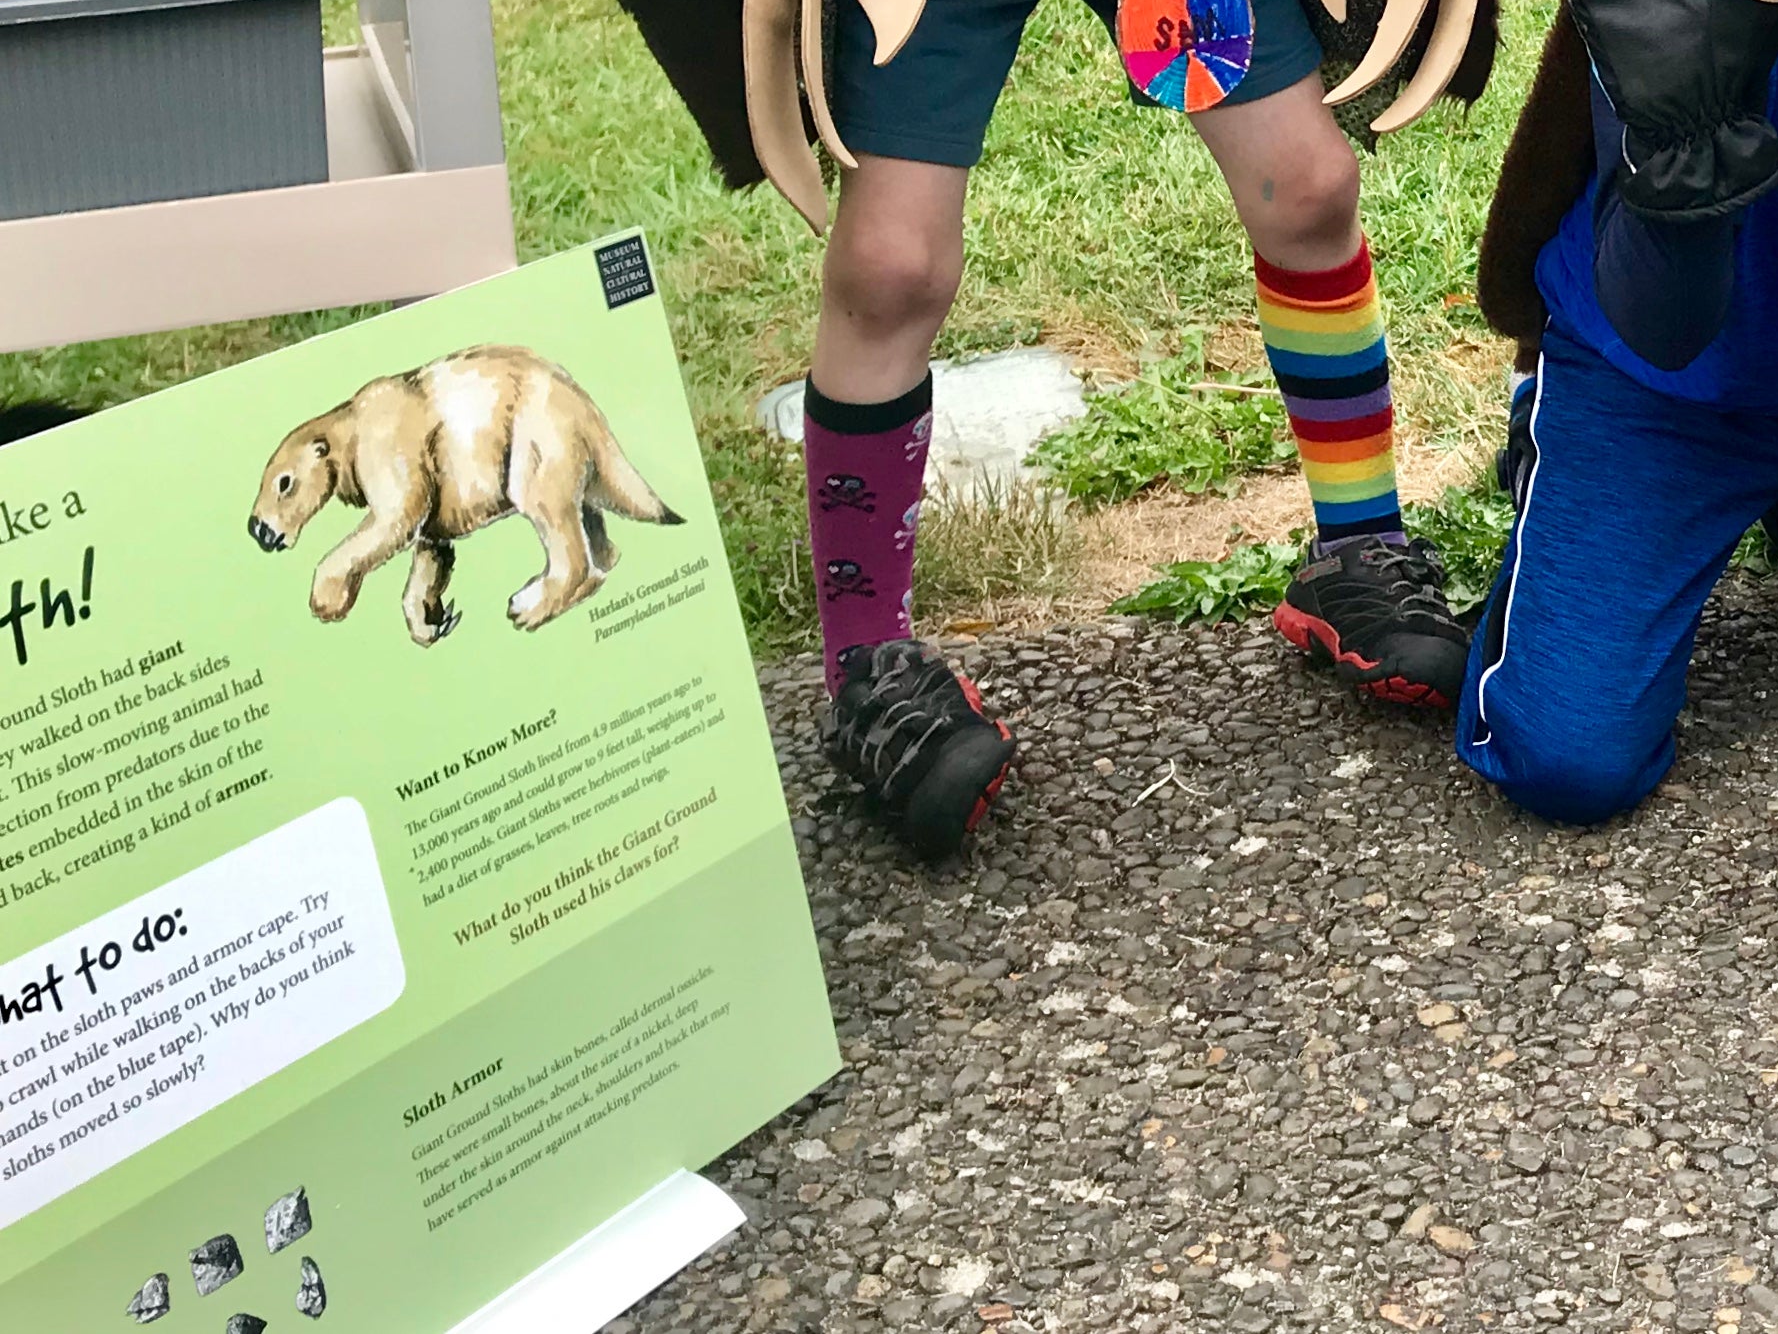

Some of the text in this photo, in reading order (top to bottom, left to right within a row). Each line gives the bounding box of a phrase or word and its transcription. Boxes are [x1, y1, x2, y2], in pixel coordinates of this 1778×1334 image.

[600, 242, 640, 262] MUSEUM
[603, 255, 643, 277] NATURAL
[606, 269, 647, 289] CULTURAL
[609, 281, 649, 303] HISTORY
[0, 488, 87, 545] ke a
[0, 546, 95, 666] th!
[588, 556, 709, 623] Harlan's Ground Sloth
[0, 640, 184, 730] ound Sloth had giant
[11, 668, 264, 794] This slow-moving animal had
[19, 714, 84, 755] walked
[87, 708, 111, 727] on
[114, 694, 142, 715] the
[144, 671, 187, 701] back
[189, 655, 230, 683] sides
[0, 703, 270, 837] ection from predators due to the
[28, 800, 121, 858] embedded
[124, 796, 143, 813] in
[146, 781, 174, 802] the
[178, 763, 213, 788] skin
[216, 746, 233, 769] of
[237, 739, 263, 759] the
[395, 708, 557, 801] Want to Know More?
[404, 819, 427, 836] The
[429, 800, 461, 824] Giant
[463, 774, 507, 806] Ground
[508, 760, 536, 783] Sloth
[537, 744, 564, 768] lived
[564, 734, 591, 754] from
[609, 705, 646, 731] million
[646, 692, 672, 714] years
[673, 682, 691, 698] ago
[691, 676, 703, 688] to
[412, 693, 717, 860] 13,000 years ago and could grow to 9 feet tall, weighing up to
[417, 858, 449, 884] 2,400
[450, 835, 495, 870] pounds.
[496, 816, 528, 840] Giant
[528, 800, 561, 824] Sloths
[562, 785, 587, 805] were
[587, 756, 641, 791] herbivores
[707, 708, 725, 728] and
[10, 868, 61, 901] back,
[64, 833, 136, 876] creating
[138, 827, 149, 841] a
[150, 800, 192, 834] kind
[195, 789, 212, 812] of
[215, 768, 273, 803] armor.
[453, 786, 718, 946] What do you think the Giant Ground
[510, 835, 679, 945] Sloth used his claws for?
[0, 907, 188, 1024] hat to do:
[0, 891, 328, 1076] t on the sloth paws and armor cape. Try
[8, 915, 344, 1105] crawl while walking on the backs of your
[52, 1092, 84, 1119] (on
[86, 1075, 115, 1098] the
[117, 1052, 156, 1081] blue
[159, 1023, 208, 1058] tape).
[210, 999, 250, 1028] Why
[254, 986, 276, 1006] do
[279, 968, 309, 998] you
[312, 941, 355, 974] think
[3, 1054, 205, 1181] sloths moved so slowly?
[403, 1058, 503, 1128] Sloth Armor
